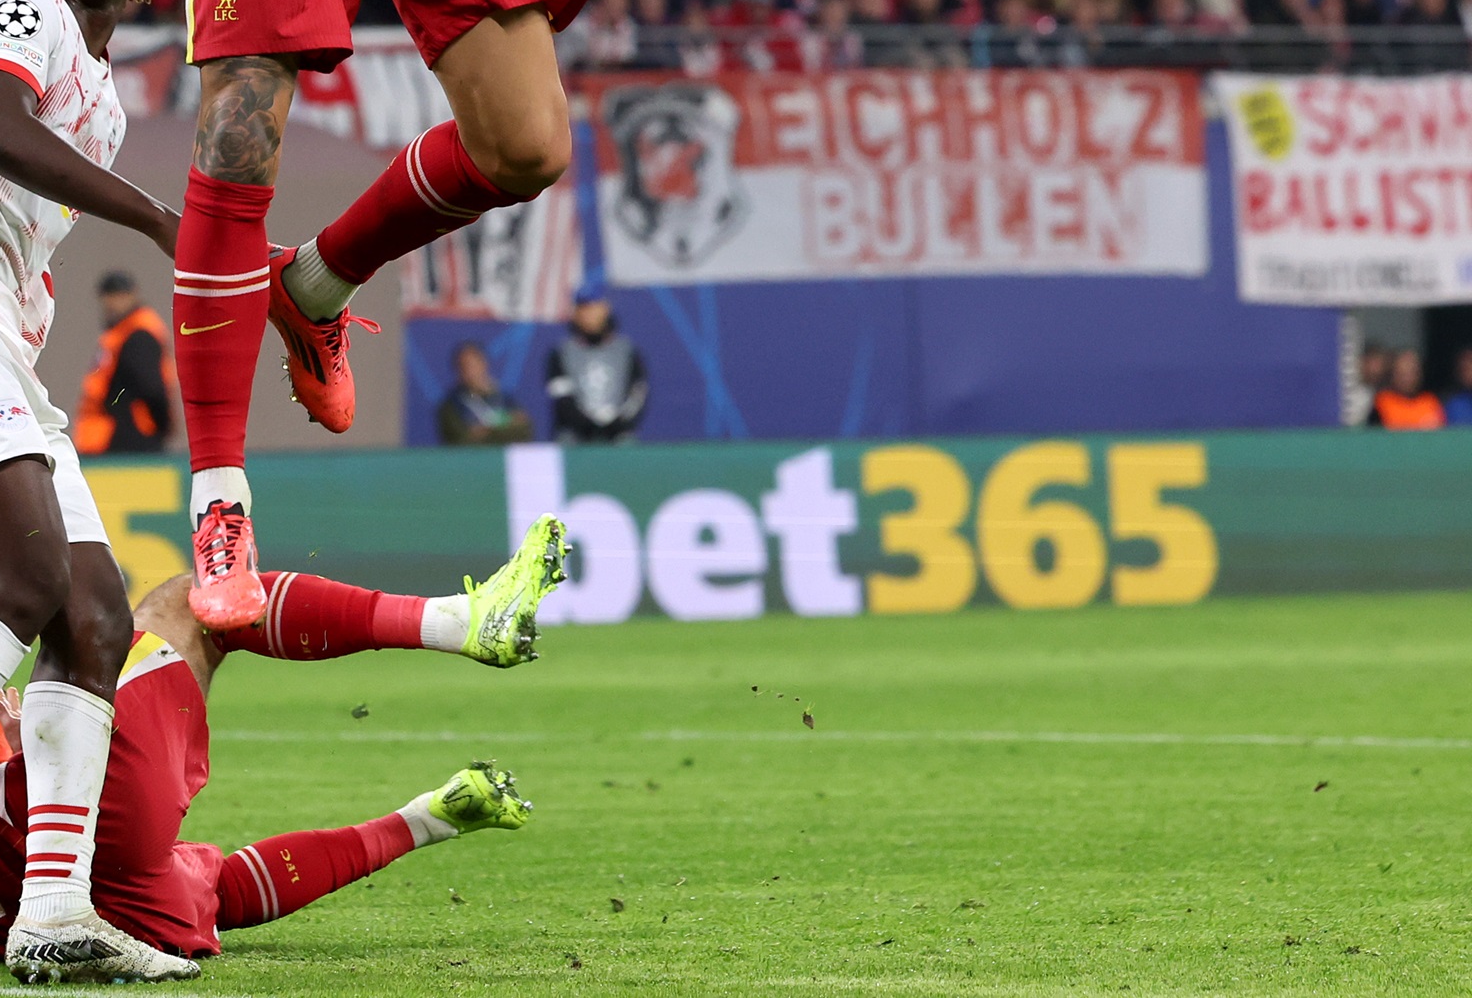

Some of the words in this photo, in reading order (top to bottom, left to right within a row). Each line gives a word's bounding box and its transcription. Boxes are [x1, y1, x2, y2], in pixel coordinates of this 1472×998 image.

[214, 9, 240, 22] L.F.C.
[758, 68, 1180, 165] EICHHOLZ
[808, 166, 1142, 266] BULLEN
[1236, 169, 1472, 240] BALLIST
[508, 442, 1220, 626] bet365
